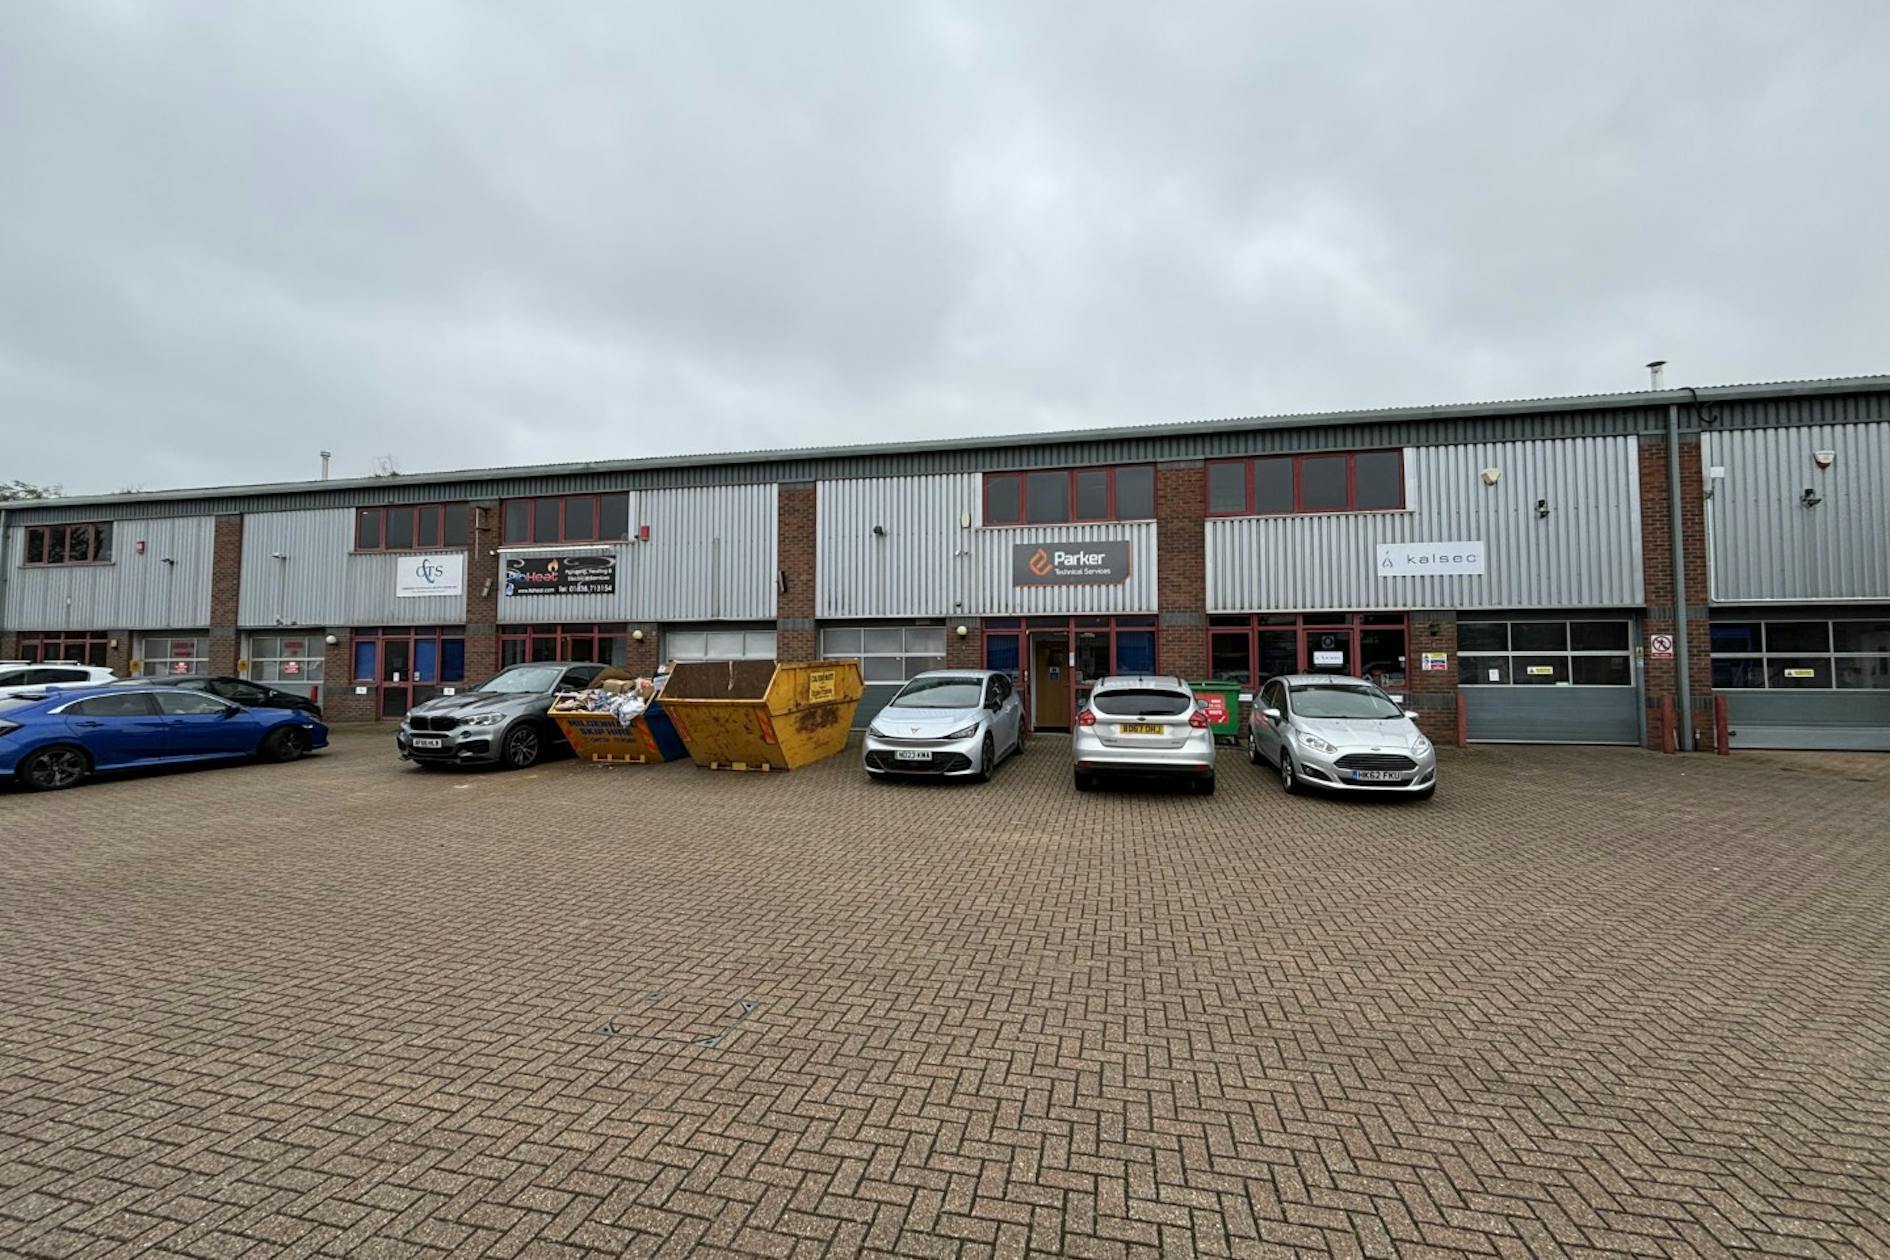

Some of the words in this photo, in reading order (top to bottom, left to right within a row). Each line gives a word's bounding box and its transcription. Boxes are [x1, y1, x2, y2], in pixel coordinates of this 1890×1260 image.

[1054, 551, 1106, 566] Parker
[1406, 553, 1477, 565] kalsec
[1055, 568, 1083, 576] Technical
[1358, 771, 1380, 779] HK62
[1383, 771, 1399, 780] FKU
